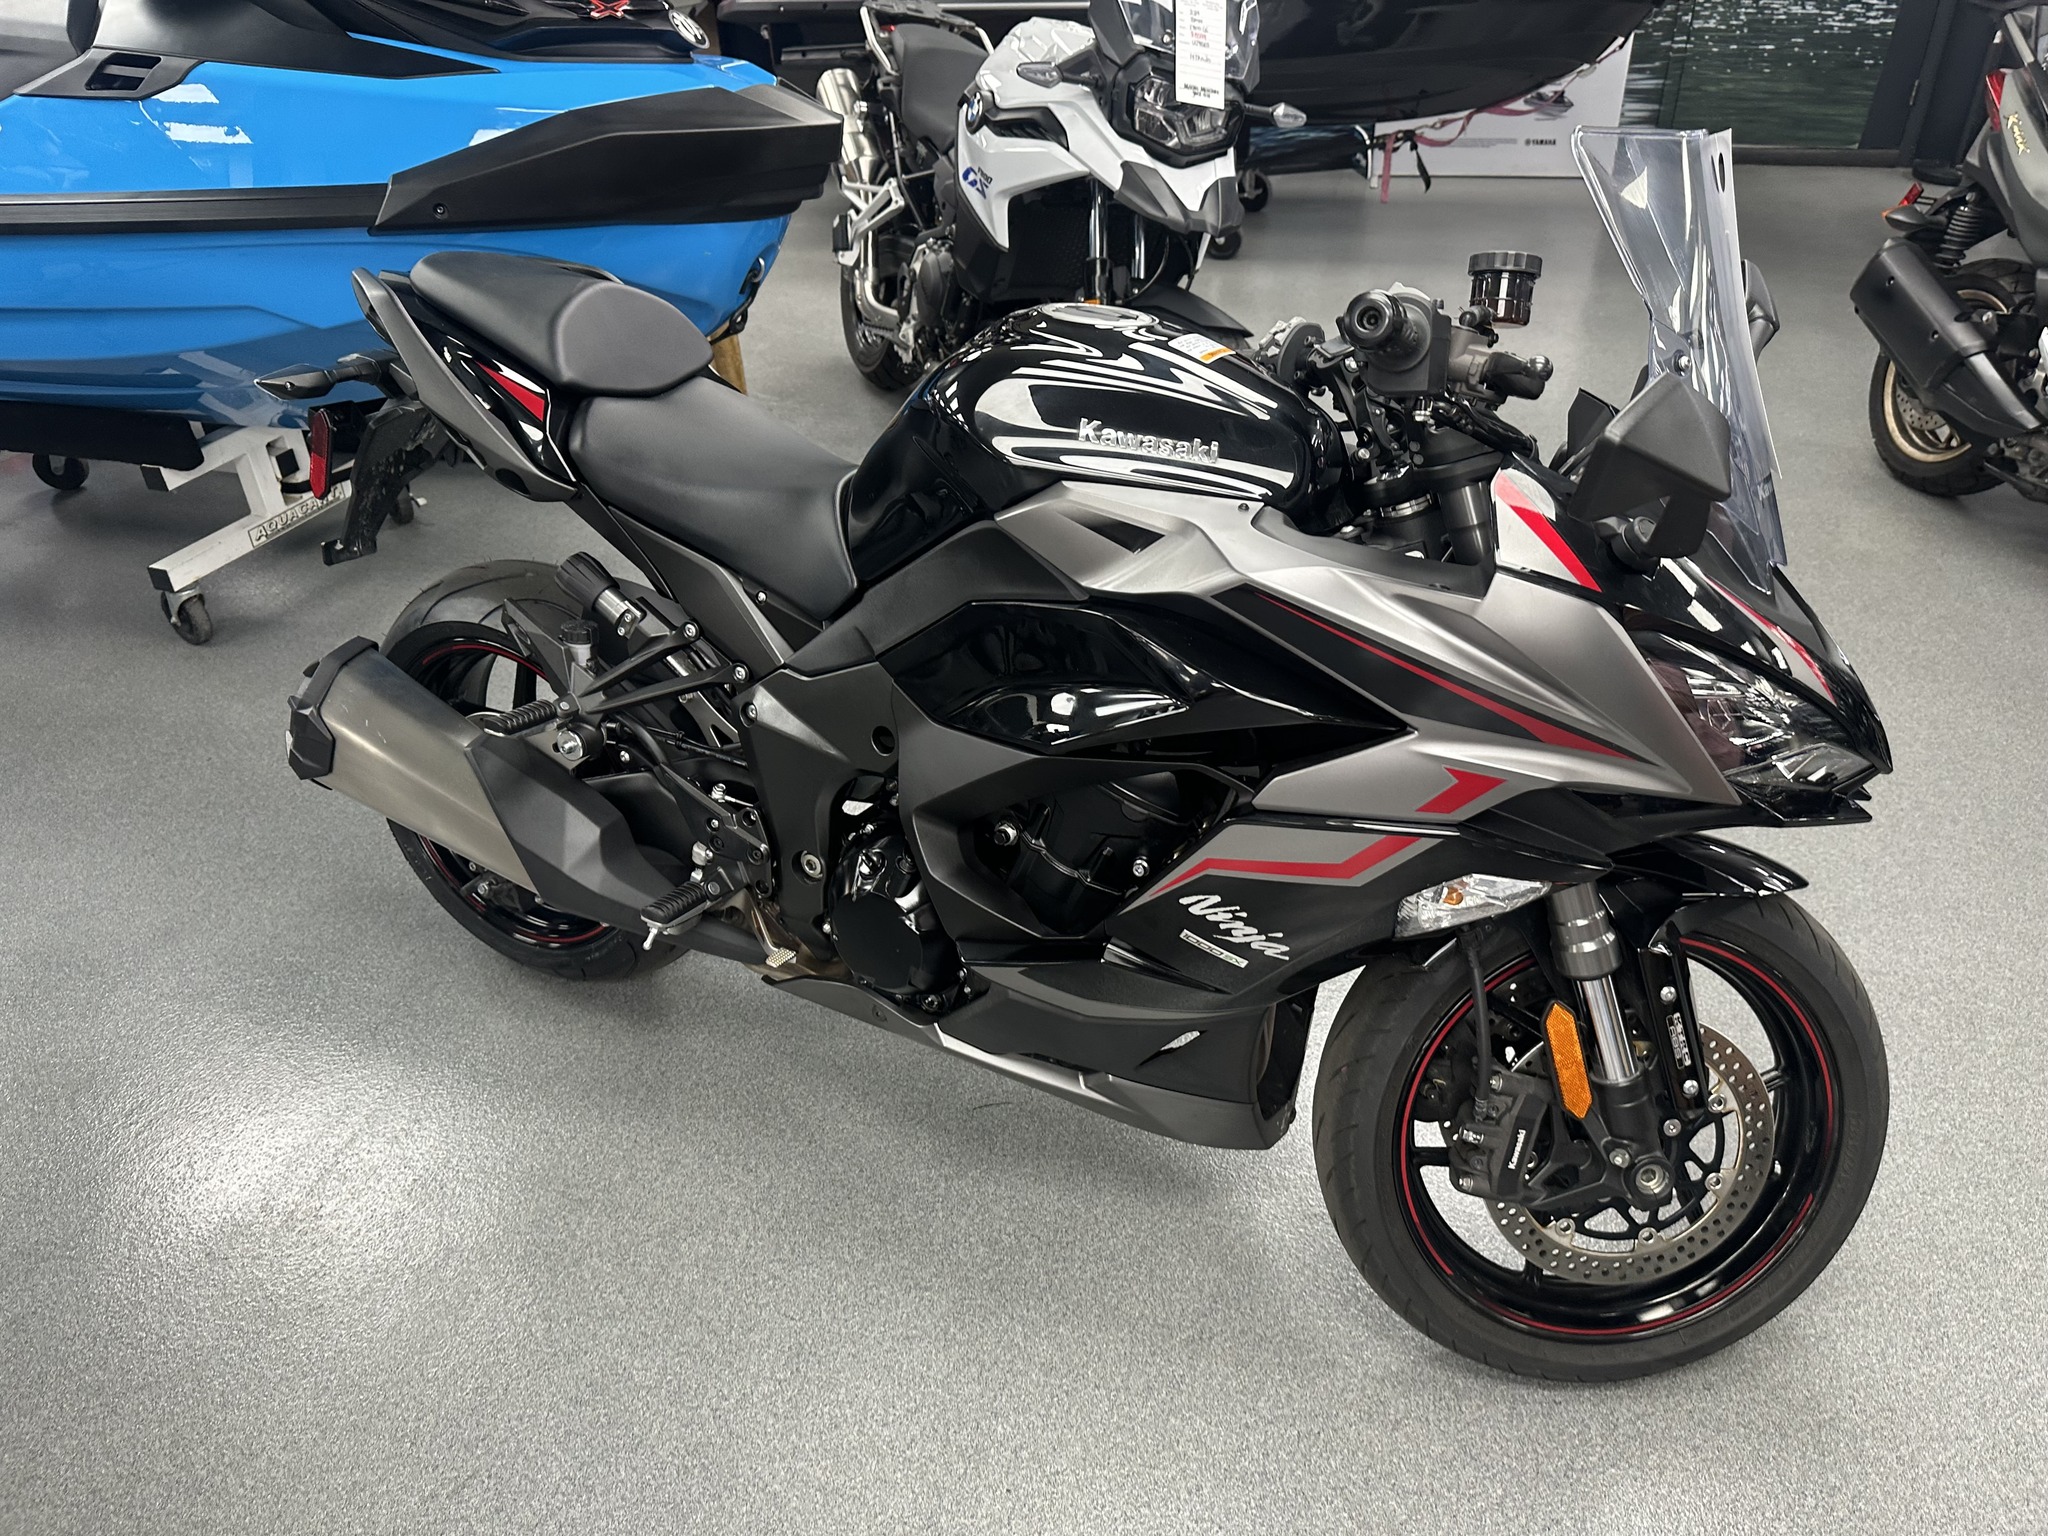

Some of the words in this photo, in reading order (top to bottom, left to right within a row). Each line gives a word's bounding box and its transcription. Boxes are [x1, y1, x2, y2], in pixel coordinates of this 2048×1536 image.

[1077, 417, 1220, 464] Kawasaki
[1178, 894, 1290, 961] Ninja
[1507, 1128, 1527, 1170] Kawasaki
